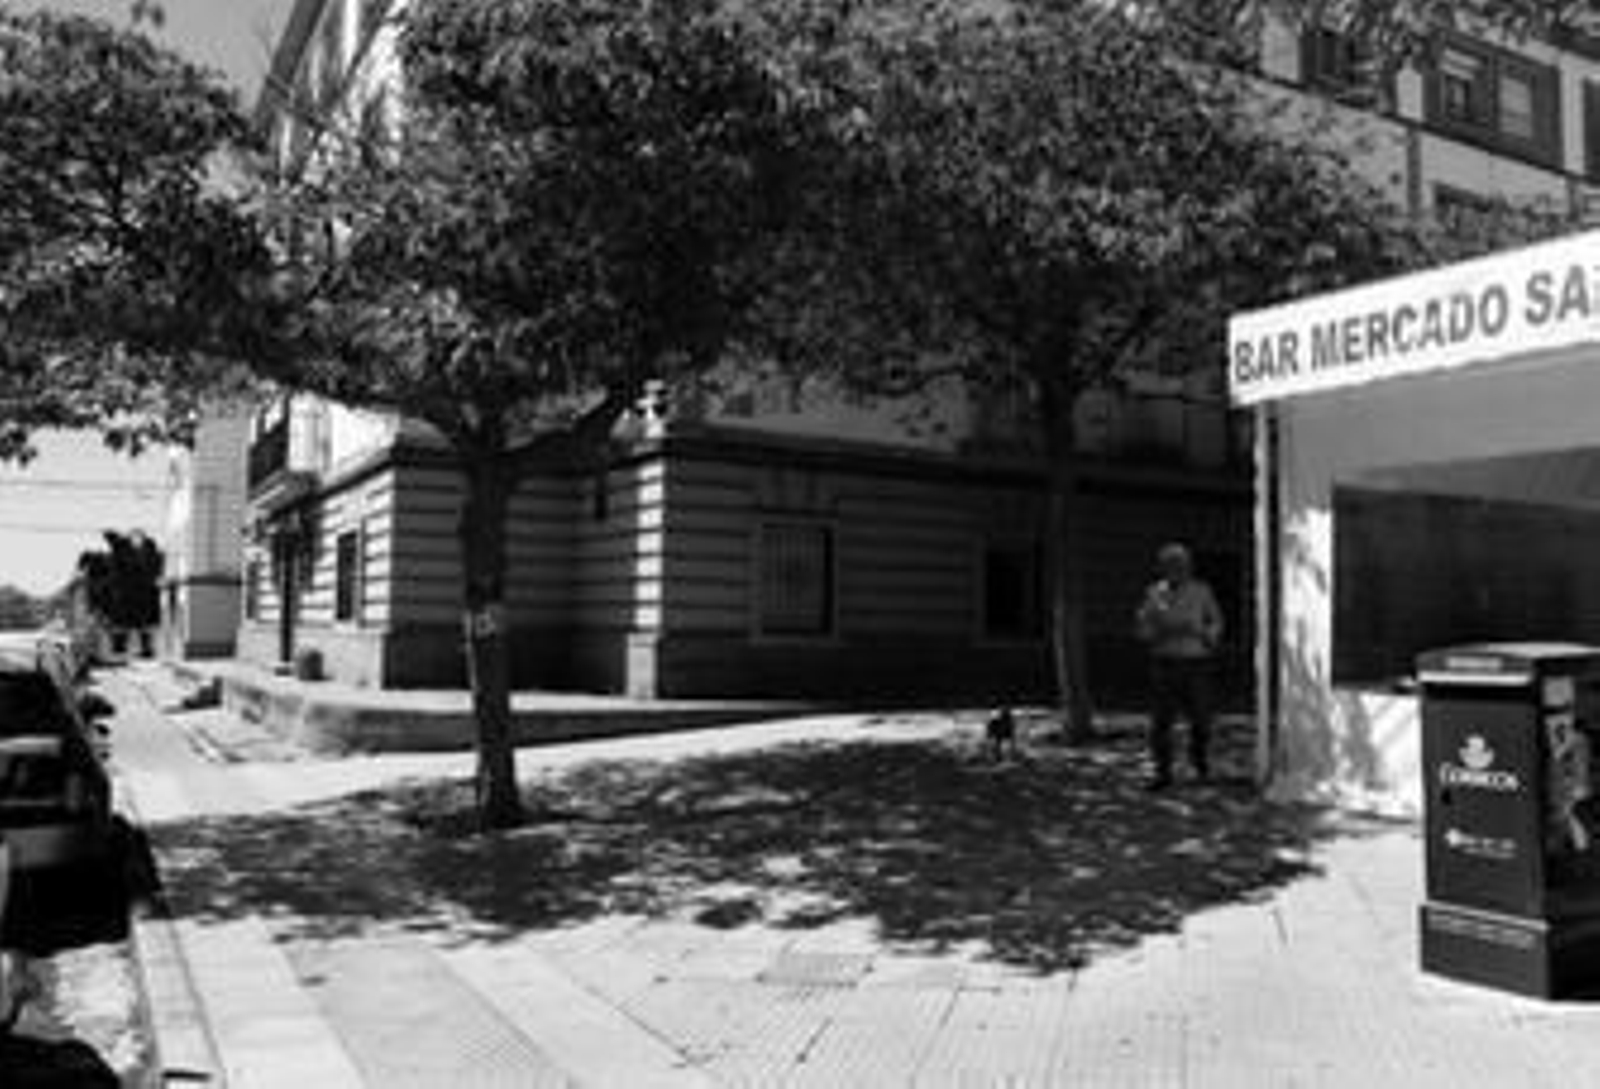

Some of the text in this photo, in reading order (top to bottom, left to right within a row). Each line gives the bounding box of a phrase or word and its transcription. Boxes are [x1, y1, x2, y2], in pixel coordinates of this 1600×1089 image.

[1235, 264, 1600, 383] BAR MERCADO SA
